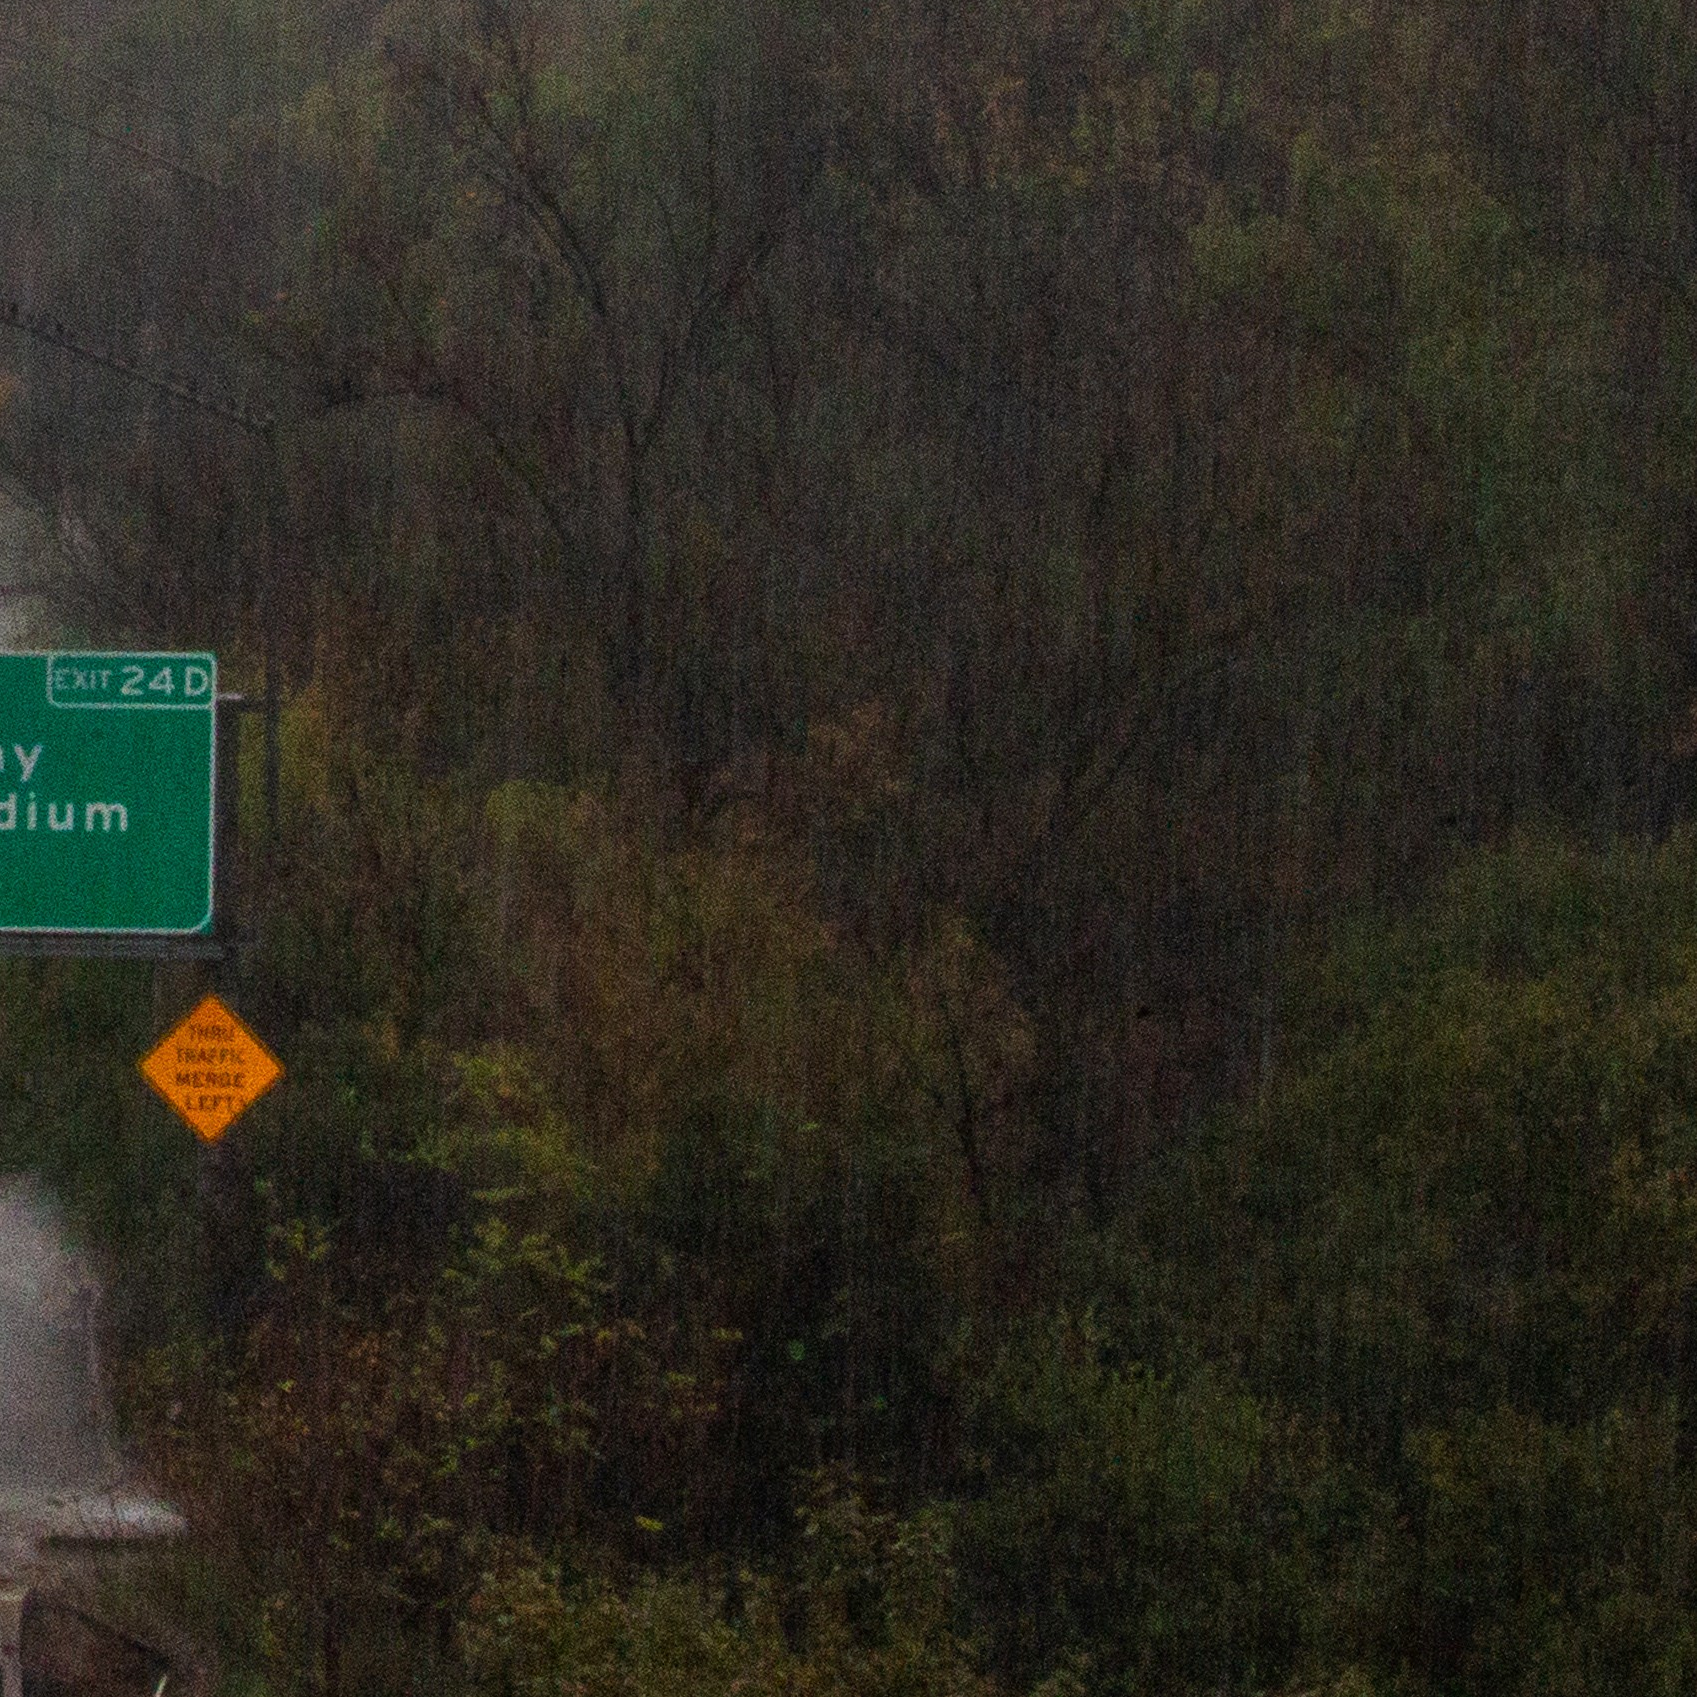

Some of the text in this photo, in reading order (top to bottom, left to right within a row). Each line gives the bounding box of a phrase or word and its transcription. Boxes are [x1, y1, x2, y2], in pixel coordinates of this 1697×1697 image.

[54, 668, 111, 692] EXIT
[188, 1024, 236, 1042] THRU
[175, 1047, 245, 1065] TRAFFIC
[175, 1071, 245, 1089] MERGE
[187, 1095, 233, 1112] LEFT
